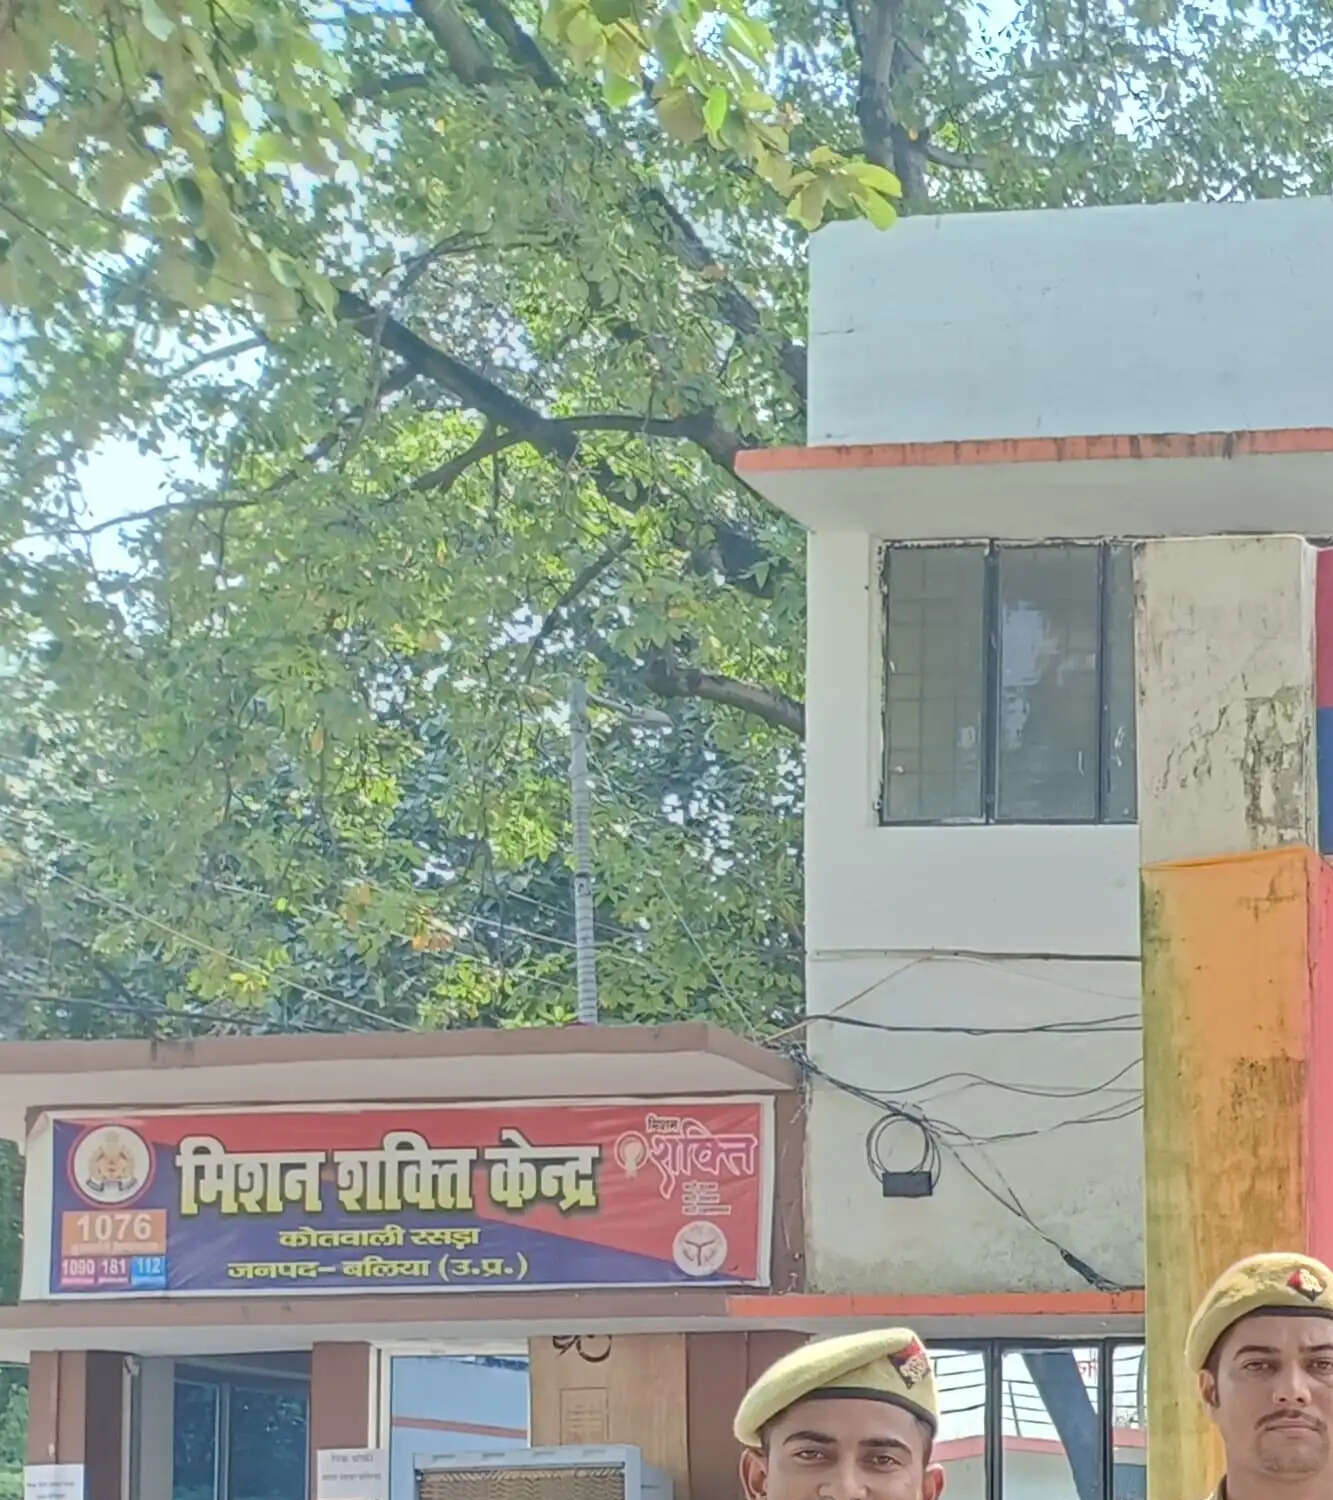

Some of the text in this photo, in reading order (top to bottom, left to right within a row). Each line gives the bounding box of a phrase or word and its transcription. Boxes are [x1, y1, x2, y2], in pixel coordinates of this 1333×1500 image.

[175, 1129, 599, 1215] मिशन शक्ति केन्द्र
[77, 1214, 152, 1241] 1076
[279, 1224, 481, 1249] कोतवाली रसड़ा
[62, 1258, 95, 1275] 1090
[102, 1258, 126, 1275] 181
[136, 1257, 161, 1274] 112
[341, 1255, 431, 1278] बलिया
